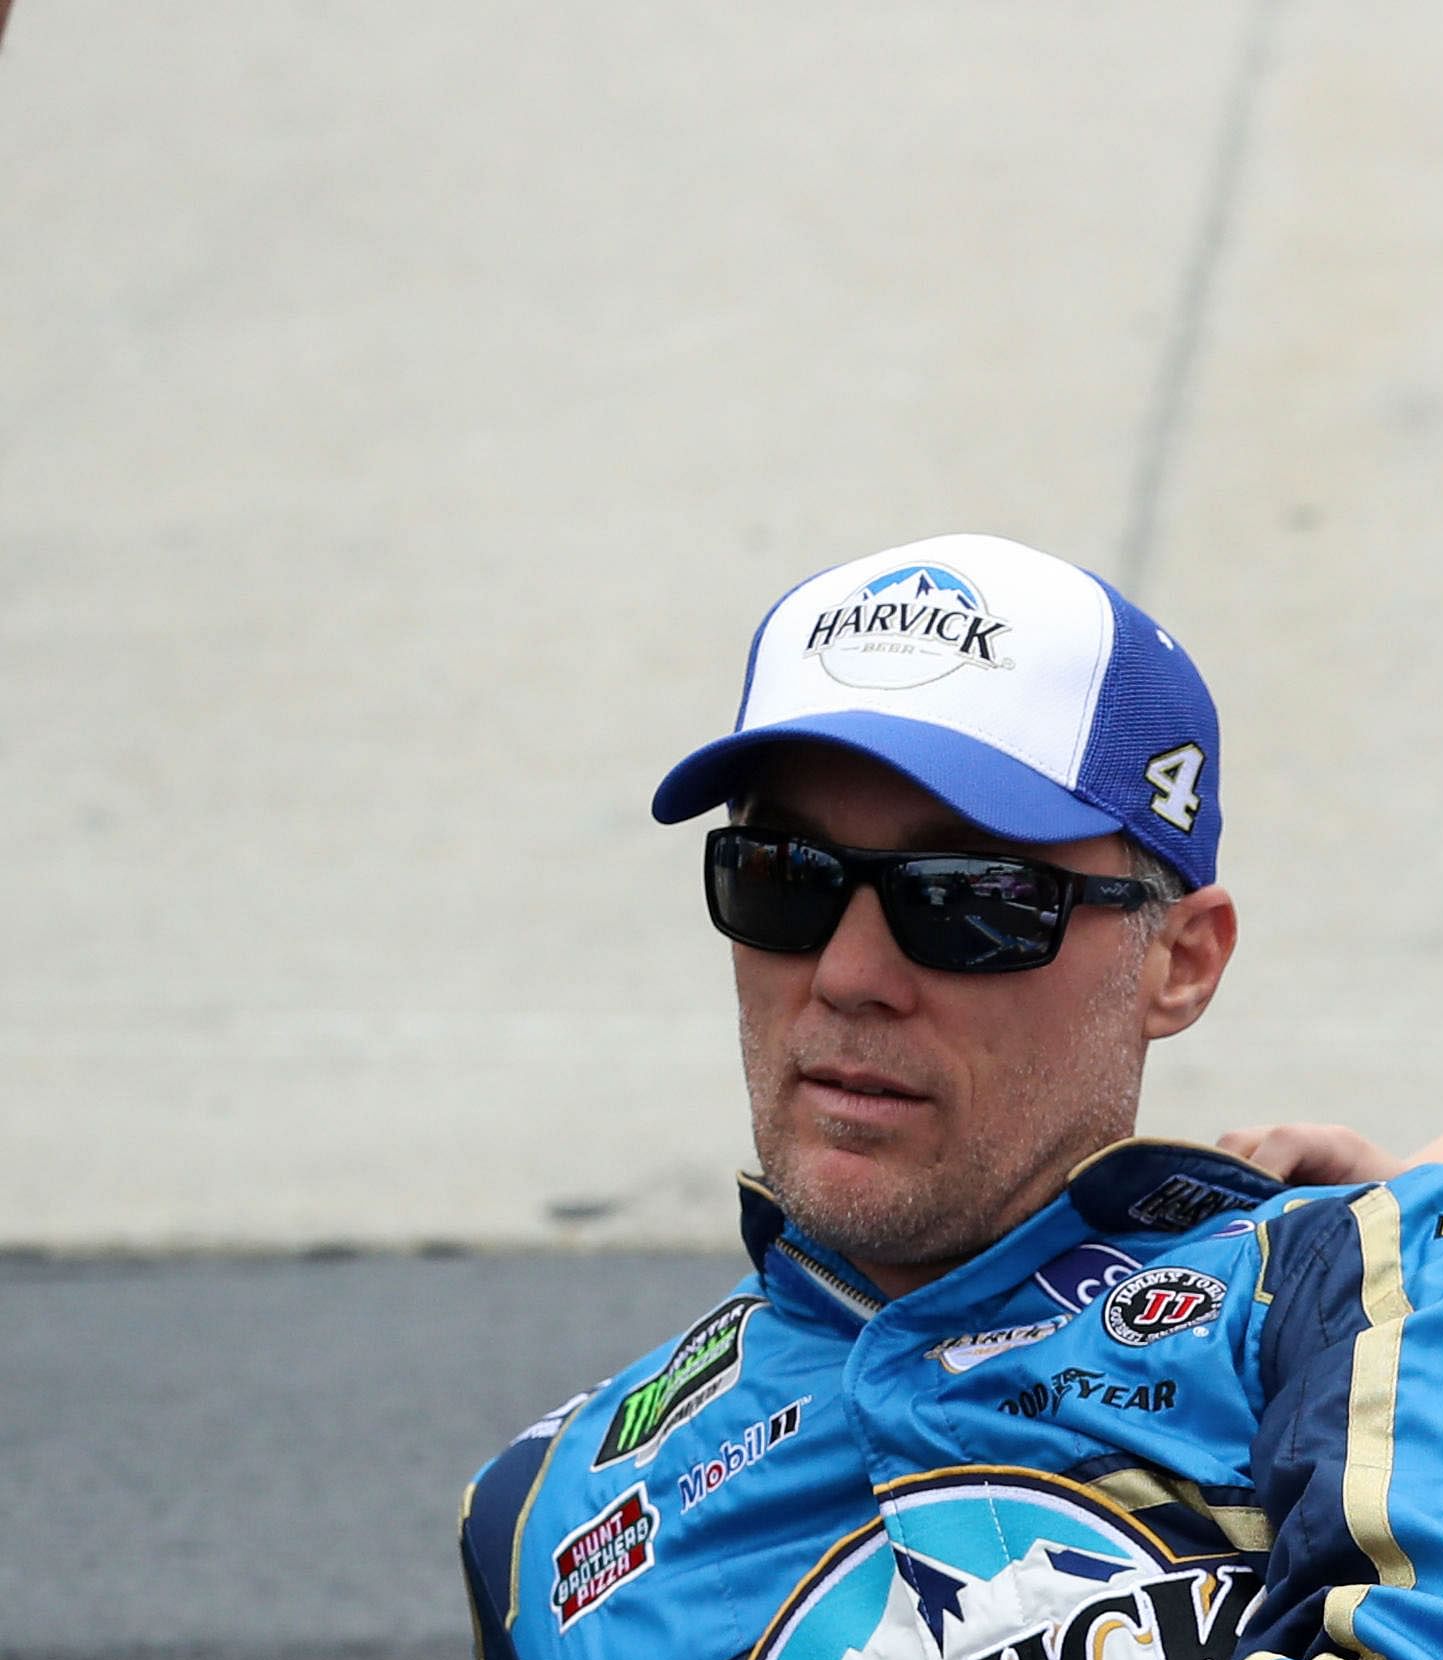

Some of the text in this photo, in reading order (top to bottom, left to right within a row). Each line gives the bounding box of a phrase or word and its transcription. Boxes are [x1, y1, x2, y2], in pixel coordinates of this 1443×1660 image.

[805, 602, 1006, 662] HARVICK
[1145, 741, 1206, 834] 4
[1133, 1289, 1205, 1326] JJ
[678, 1422, 765, 1515] Mobil
[572, 1511, 624, 1567] HUNT
[576, 1553, 631, 1607] PIZZA
